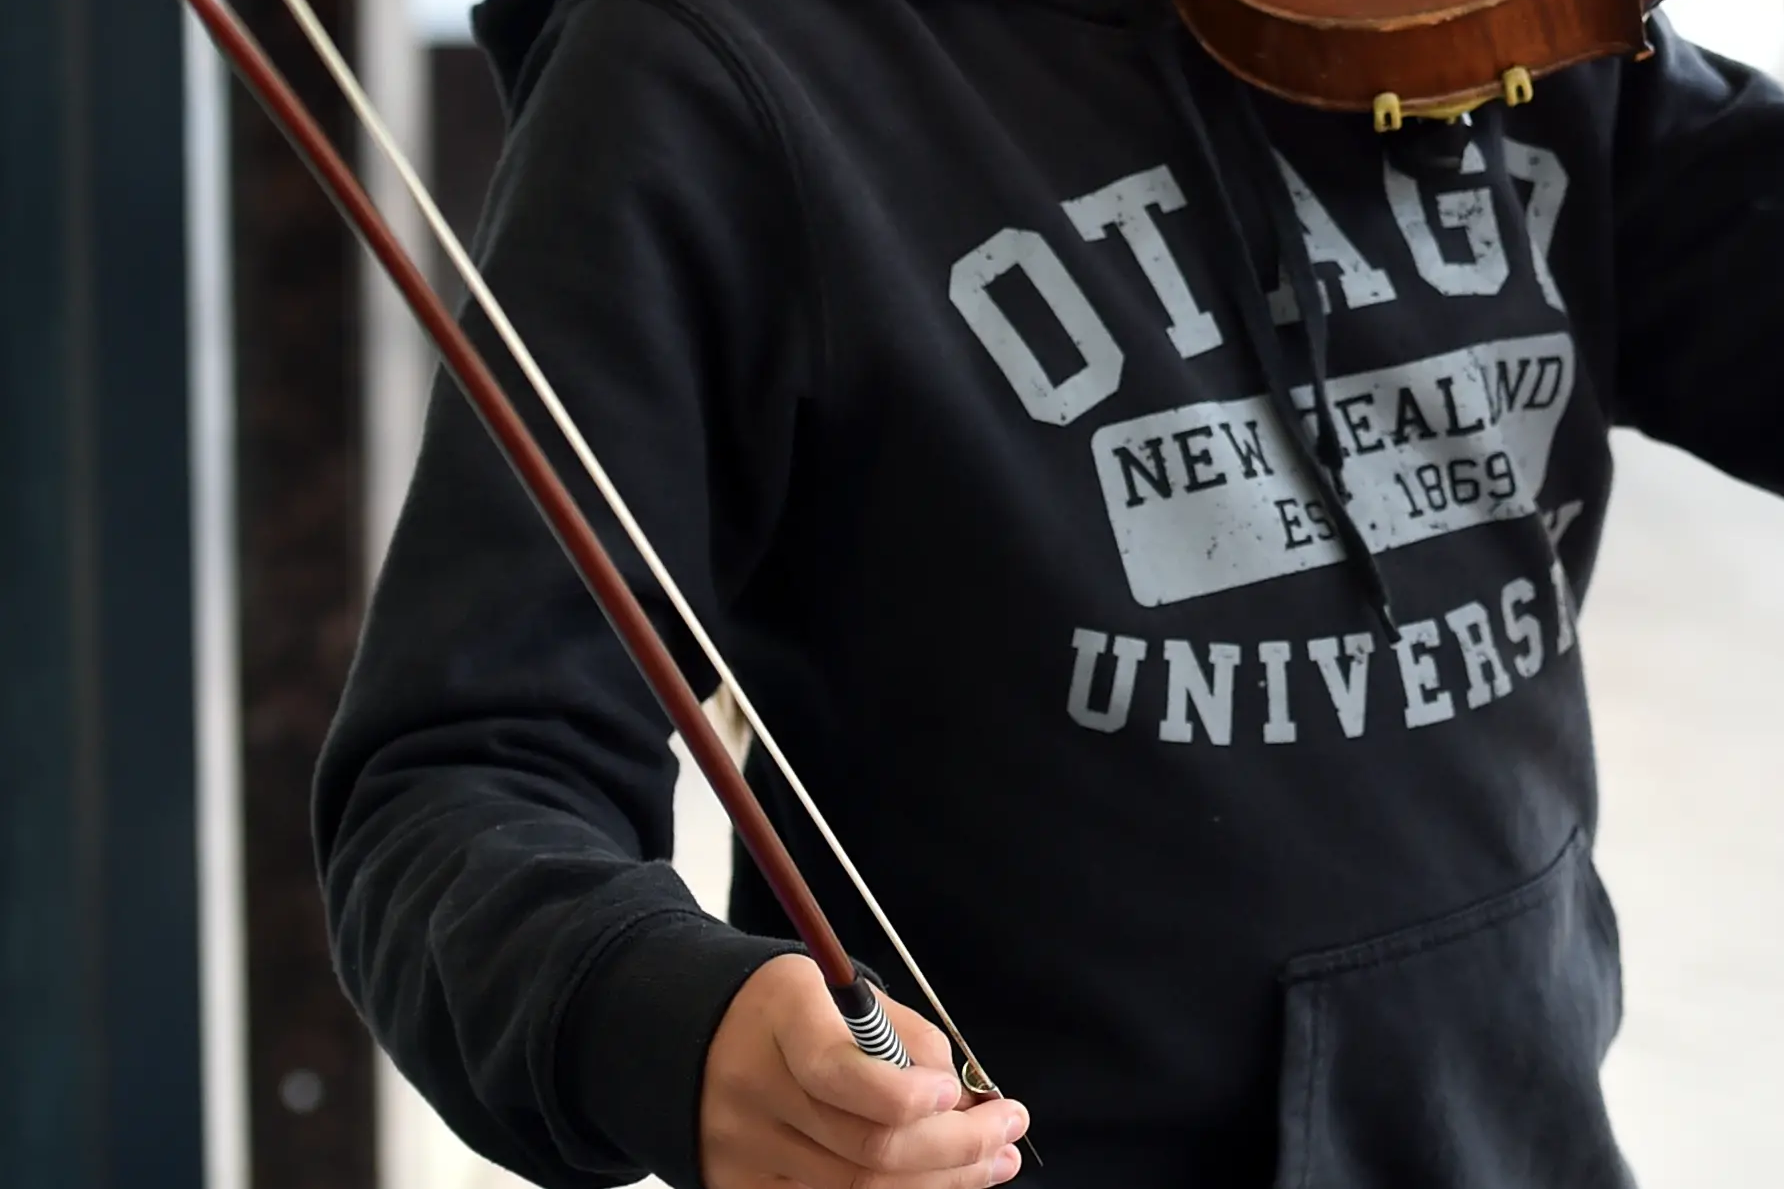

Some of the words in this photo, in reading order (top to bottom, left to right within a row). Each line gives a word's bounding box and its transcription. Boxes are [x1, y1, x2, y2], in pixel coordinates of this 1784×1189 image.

[1113, 420, 1275, 508] NEW
[1304, 356, 1563, 462] EALND
[1394, 451, 1518, 518] 1869
